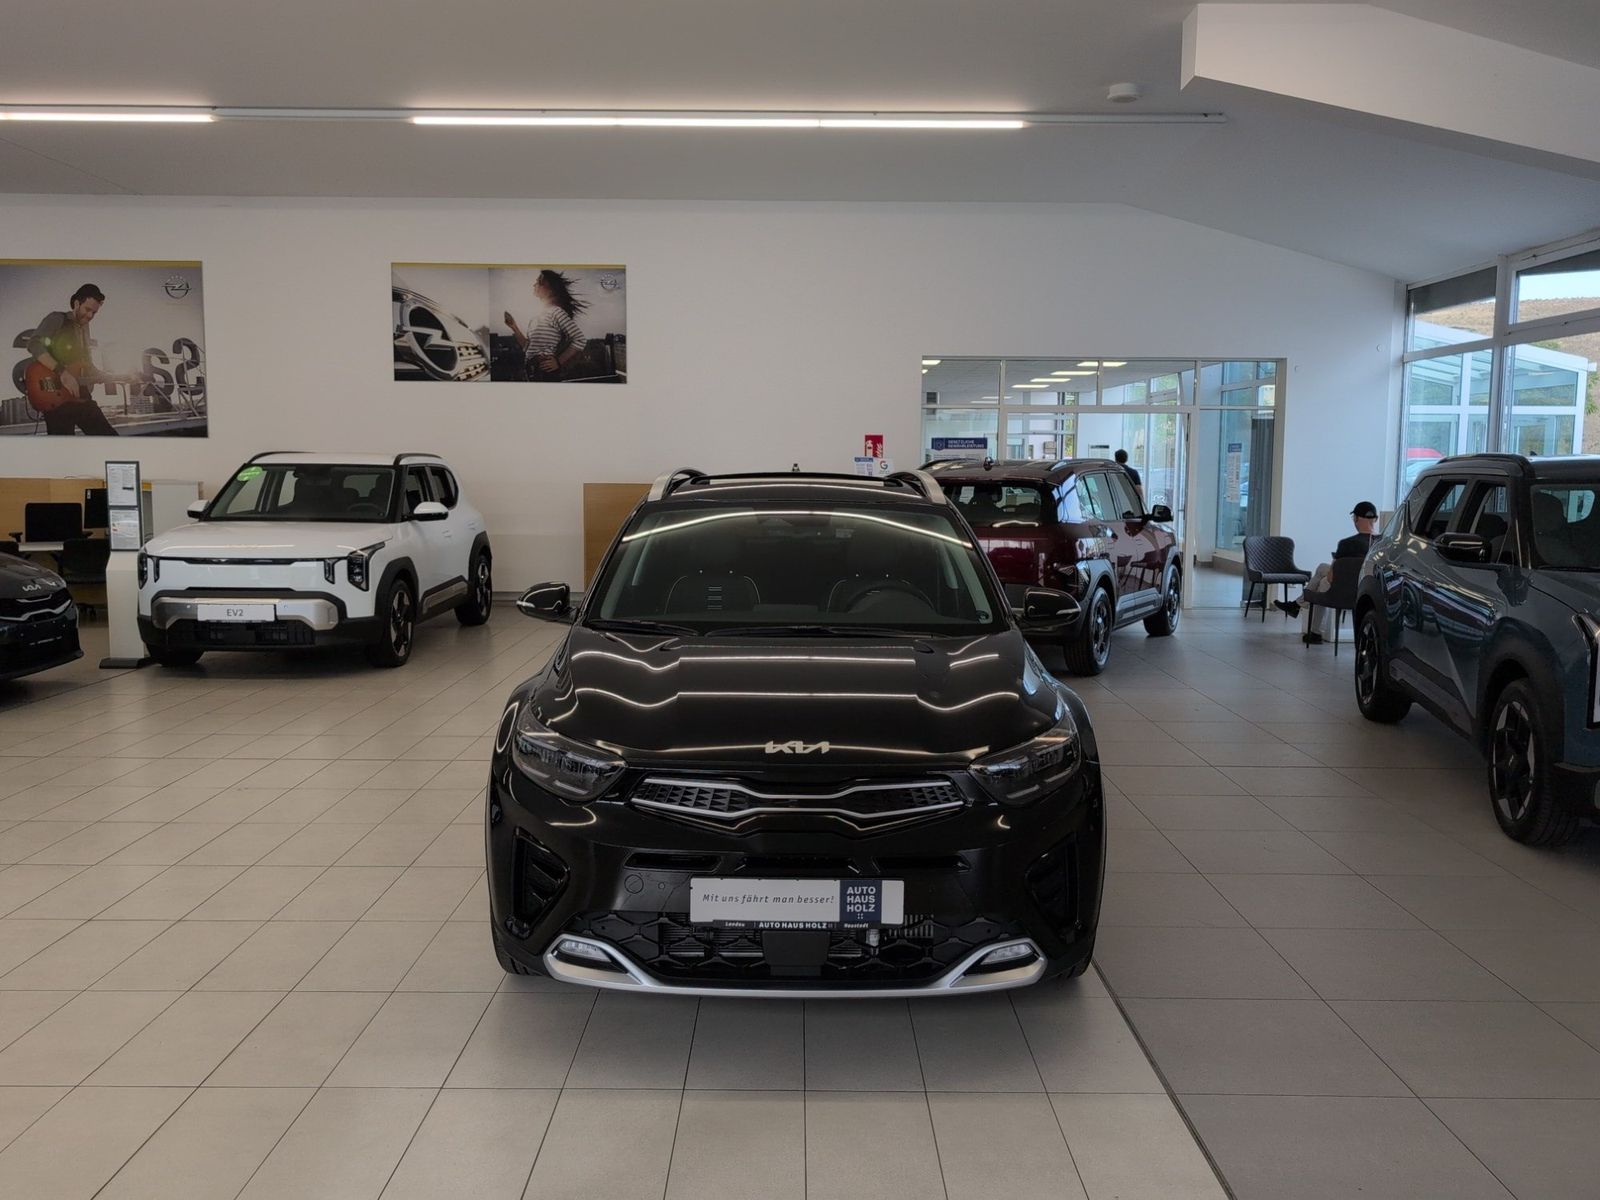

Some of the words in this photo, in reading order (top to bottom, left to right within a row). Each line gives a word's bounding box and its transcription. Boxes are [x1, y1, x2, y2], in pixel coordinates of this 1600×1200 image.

[226, 608, 244, 617] EV2
[765, 740, 830, 754] KIA
[846, 886, 876, 895] AUTO
[702, 893, 719, 902] Mit
[740, 894, 769, 905] fährt
[796, 895, 834, 904] besser!
[846, 895, 876, 904] HAUS
[846, 904, 876, 913] HOLZ
